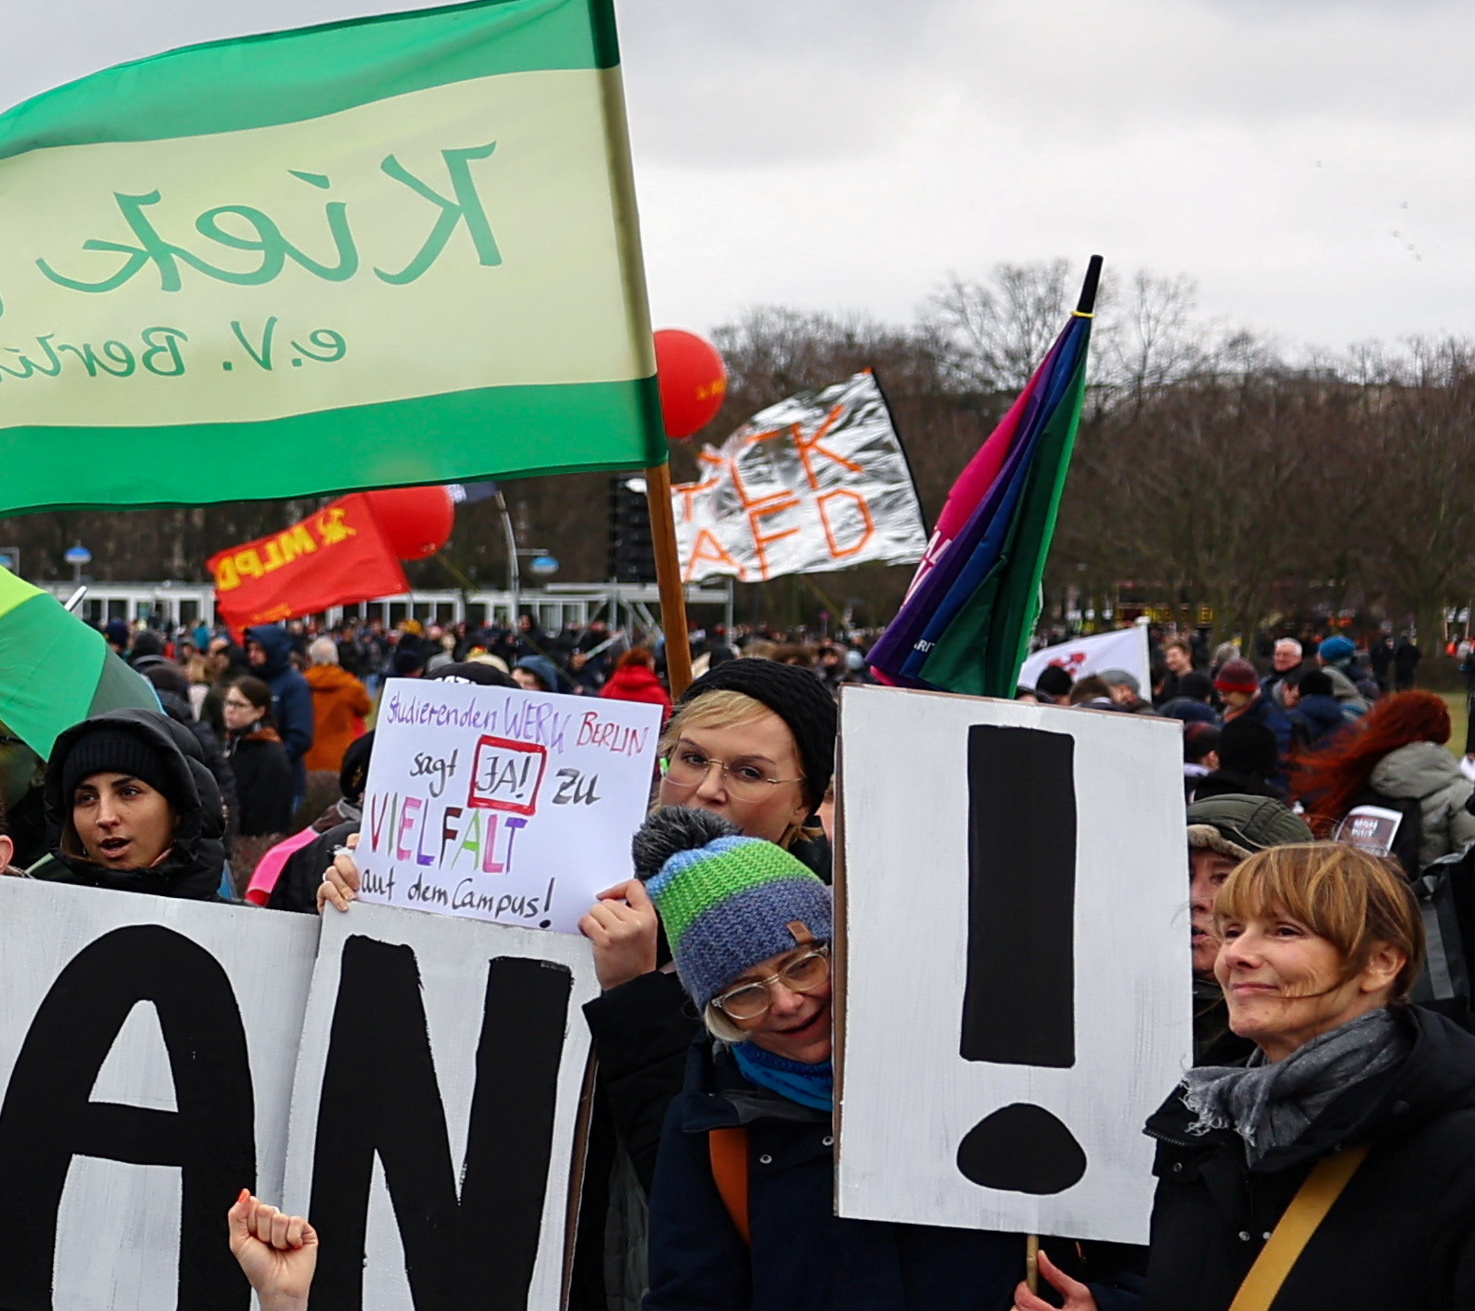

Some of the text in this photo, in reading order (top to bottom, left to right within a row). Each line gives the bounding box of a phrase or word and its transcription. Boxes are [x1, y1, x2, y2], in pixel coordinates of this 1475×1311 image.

[576, 711, 650, 756] BERLIN
[409, 748, 459, 798] sagt
[476, 755, 534, 798] JA!
[370, 791, 529, 876] VIELFALT
[407, 876, 556, 929] dem Campus!
